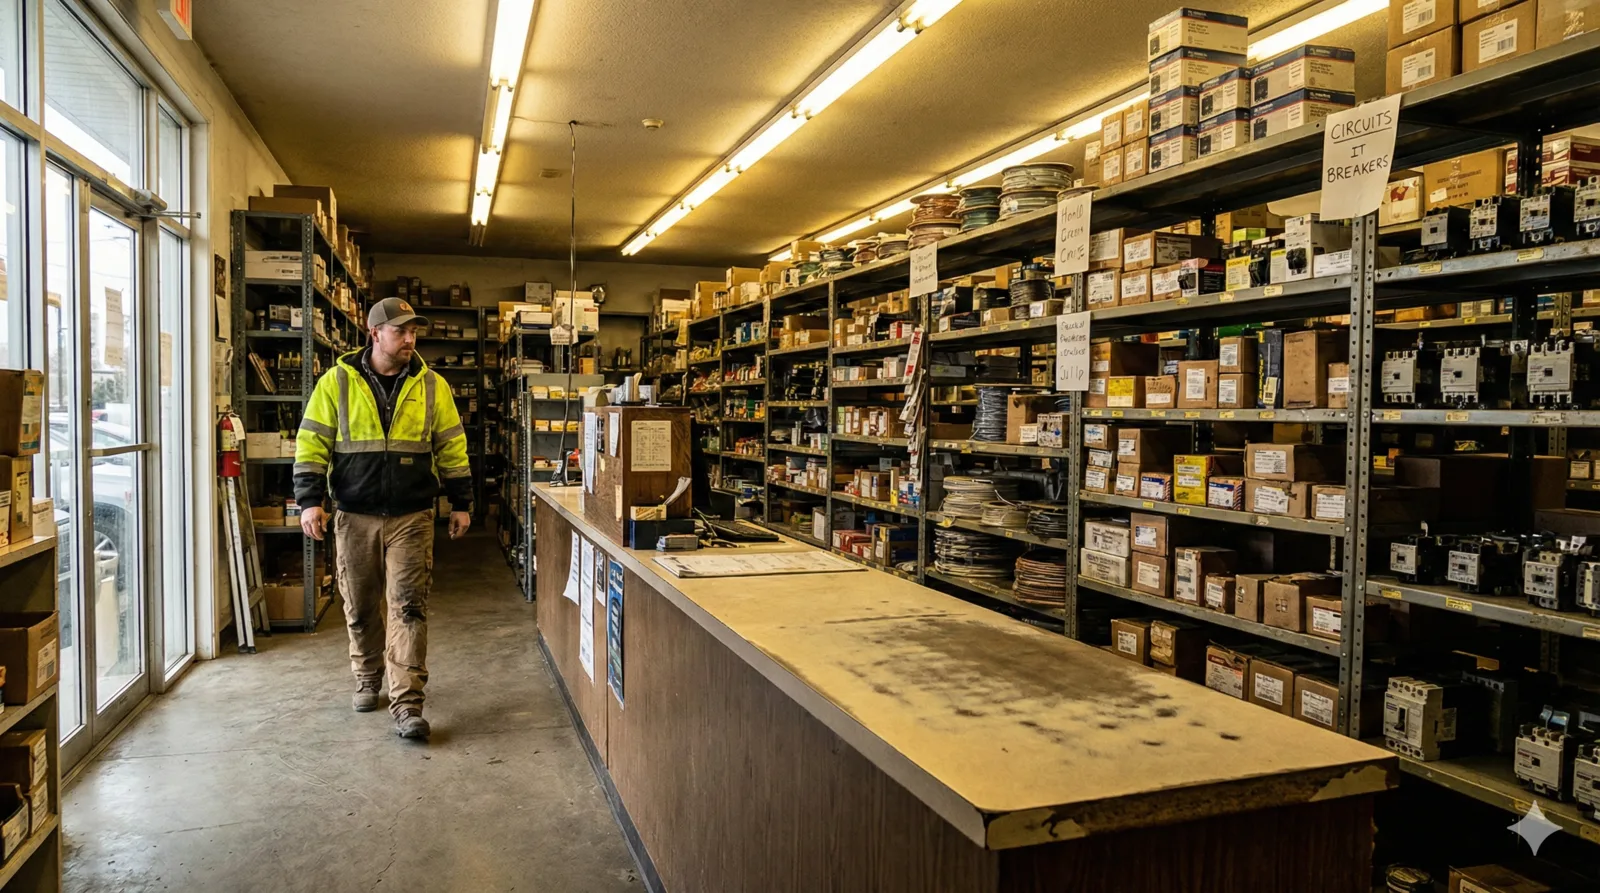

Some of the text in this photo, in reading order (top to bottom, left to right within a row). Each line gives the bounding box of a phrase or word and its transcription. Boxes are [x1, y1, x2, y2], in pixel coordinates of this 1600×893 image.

[1330, 110, 1392, 140] CIRCUITS
[1350, 143, 1366, 159] IT
[1326, 154, 1389, 183] BREAKERS
